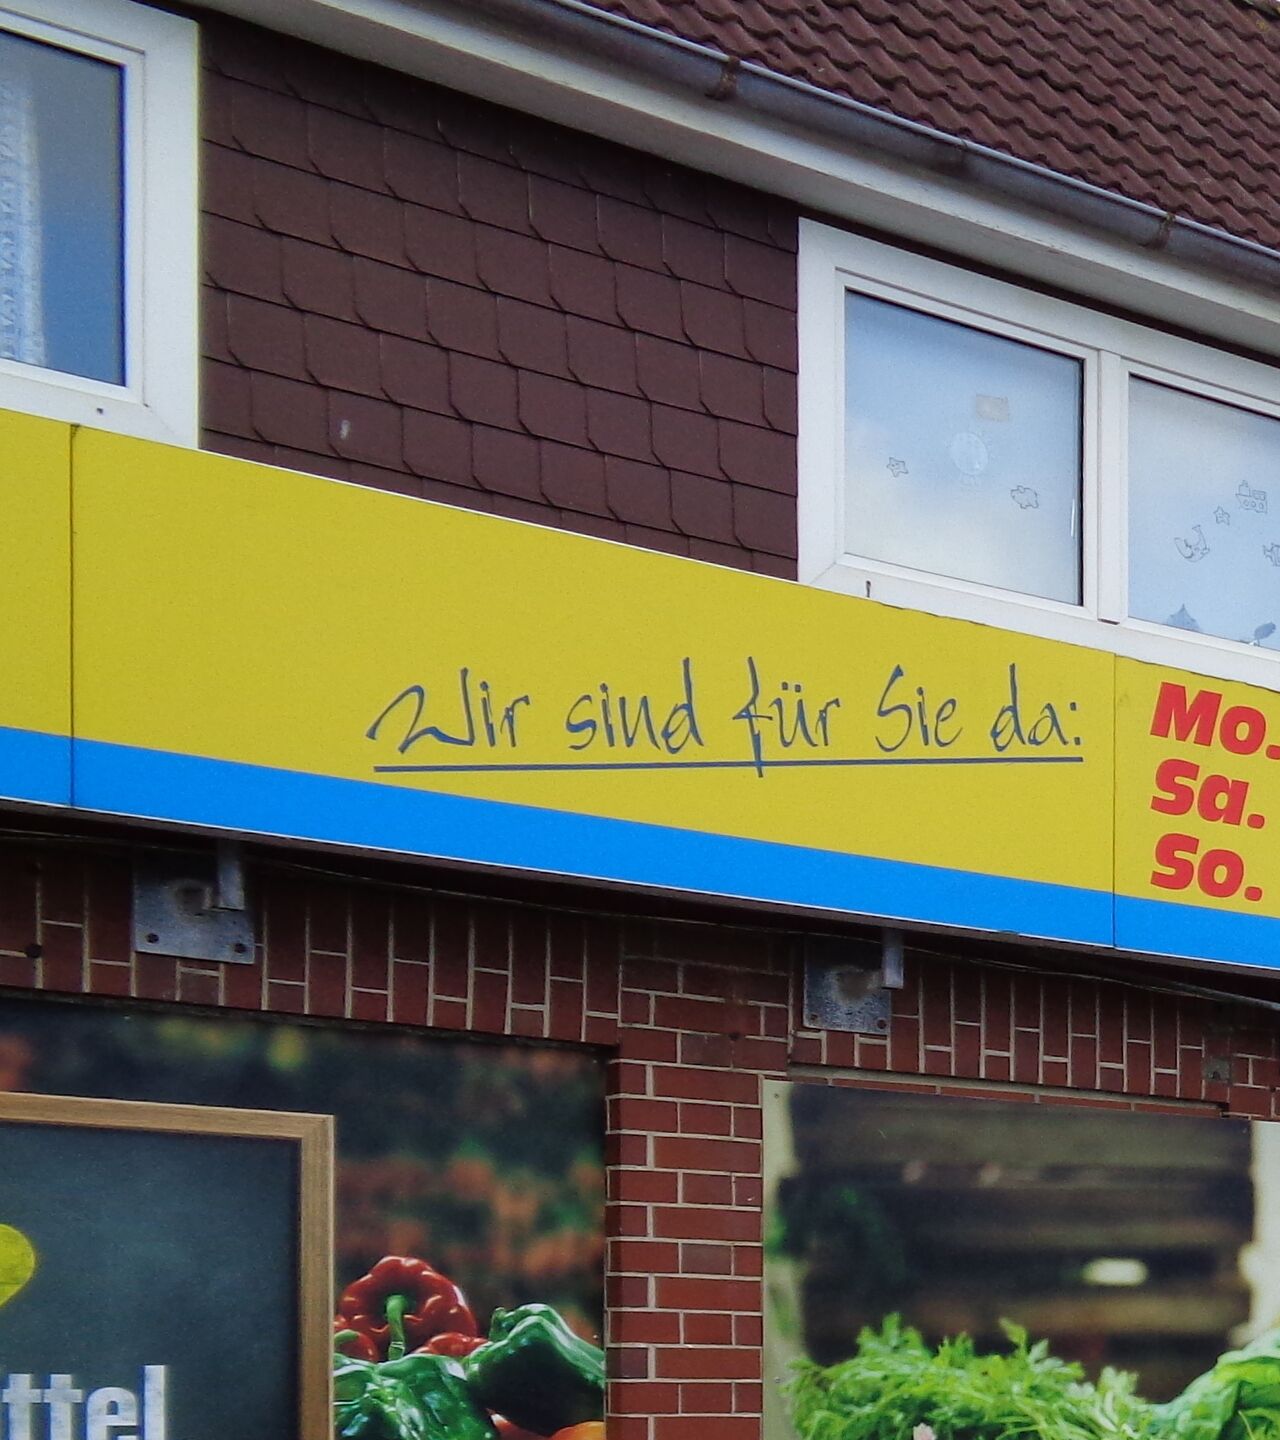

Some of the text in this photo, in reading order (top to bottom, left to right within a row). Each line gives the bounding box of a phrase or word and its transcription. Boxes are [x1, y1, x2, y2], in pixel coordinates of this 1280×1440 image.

[367, 656, 1083, 777] Wir sind für Sie da:
[1150, 758, 1266, 830] Sa.
[1150, 832, 1264, 902] So.
